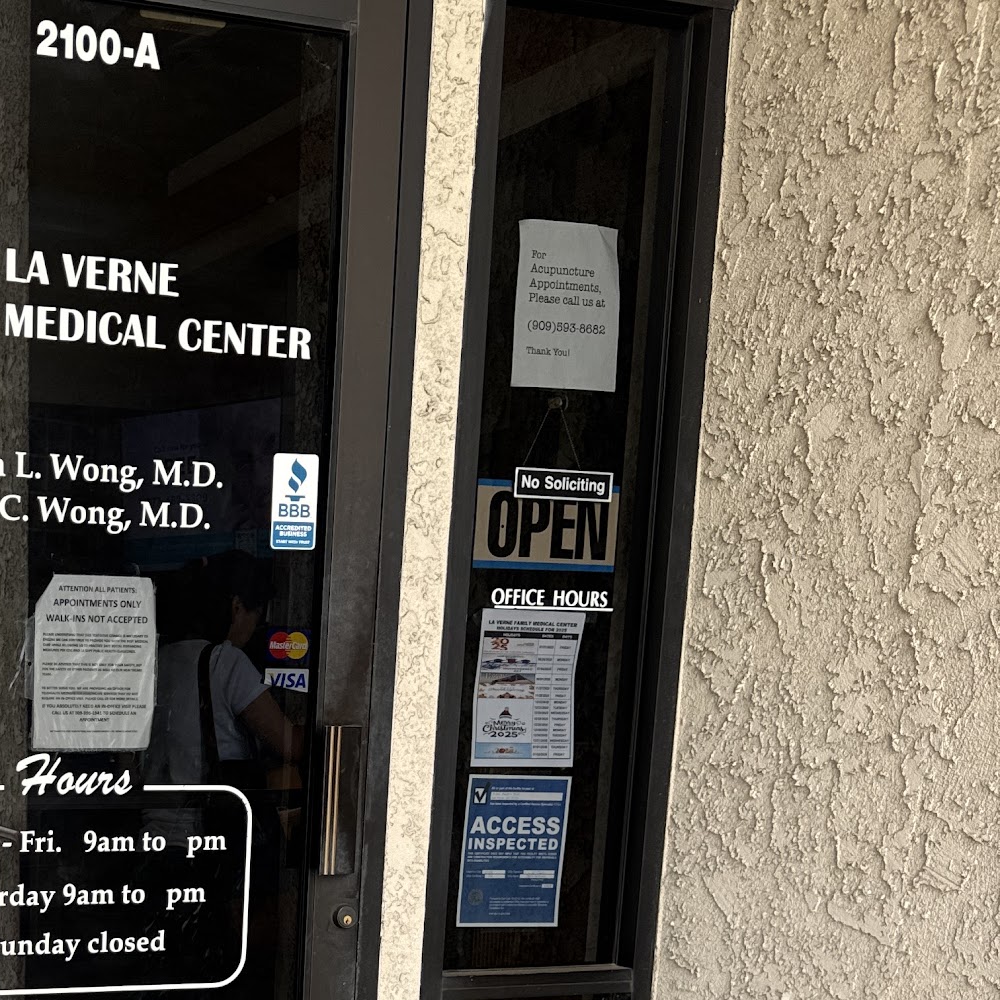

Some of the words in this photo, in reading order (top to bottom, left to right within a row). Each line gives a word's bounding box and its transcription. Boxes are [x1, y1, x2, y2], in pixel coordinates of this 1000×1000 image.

[36, 20, 160, 69] 2100-A
[531, 250, 547, 260] For
[5, 248, 49, 285] LA
[63, 253, 179, 297] VERNE
[530, 263, 595, 278] Acupuncture
[529, 278, 602, 295] Appointments,
[529, 293, 560, 304] Please
[562, 295, 580, 306] call
[582, 299, 594, 307] us
[595, 299, 606, 308] at
[5, 305, 166, 349] MEDICAL
[178, 318, 311, 360] CENTER
[527, 320, 606, 335] (909)593-8682
[526, 346, 551, 356] Thank
[553, 348, 571, 357] You!
[16, 452, 42, 480] L.
[49, 453, 144, 490] Wong,
[152, 459, 223, 489] M.D.
[521, 474, 540, 489] No
[544, 476, 605, 496] Soliciting
[0, 495, 28, 522] C.
[37, 496, 131, 535] Wong,
[139, 502, 210, 530] M.D.
[278, 503, 310, 518] BBB
[487, 490, 610, 560] OPEN
[58, 585, 94, 593] ATTENTION
[491, 588, 545, 606] OFFICE
[553, 590, 608, 608] HOURS
[53, 598, 118, 608] APPOINTMENTS
[120, 600, 142, 609] ONLY
[46, 614, 86, 623] WALK-INS
[88, 615, 105, 623] NOT
[107, 615, 148, 624] ACCEPTED
[269, 641, 308, 650] MasterCard
[267, 673, 306, 688] VISA
[16, 753, 133, 795] Hours
[470, 816, 561, 835] ACCESS
[19, 830, 62, 853] Fri.
[83, 831, 135, 852] 9am
[142, 832, 166, 851] to
[186, 832, 227, 858] pm
[467, 837, 559, 850] INSPECTED
[63, 884, 114, 905] 9am
[122, 885, 145, 905] to
[166, 886, 206, 910] pm
[88, 930, 166, 954] closed
